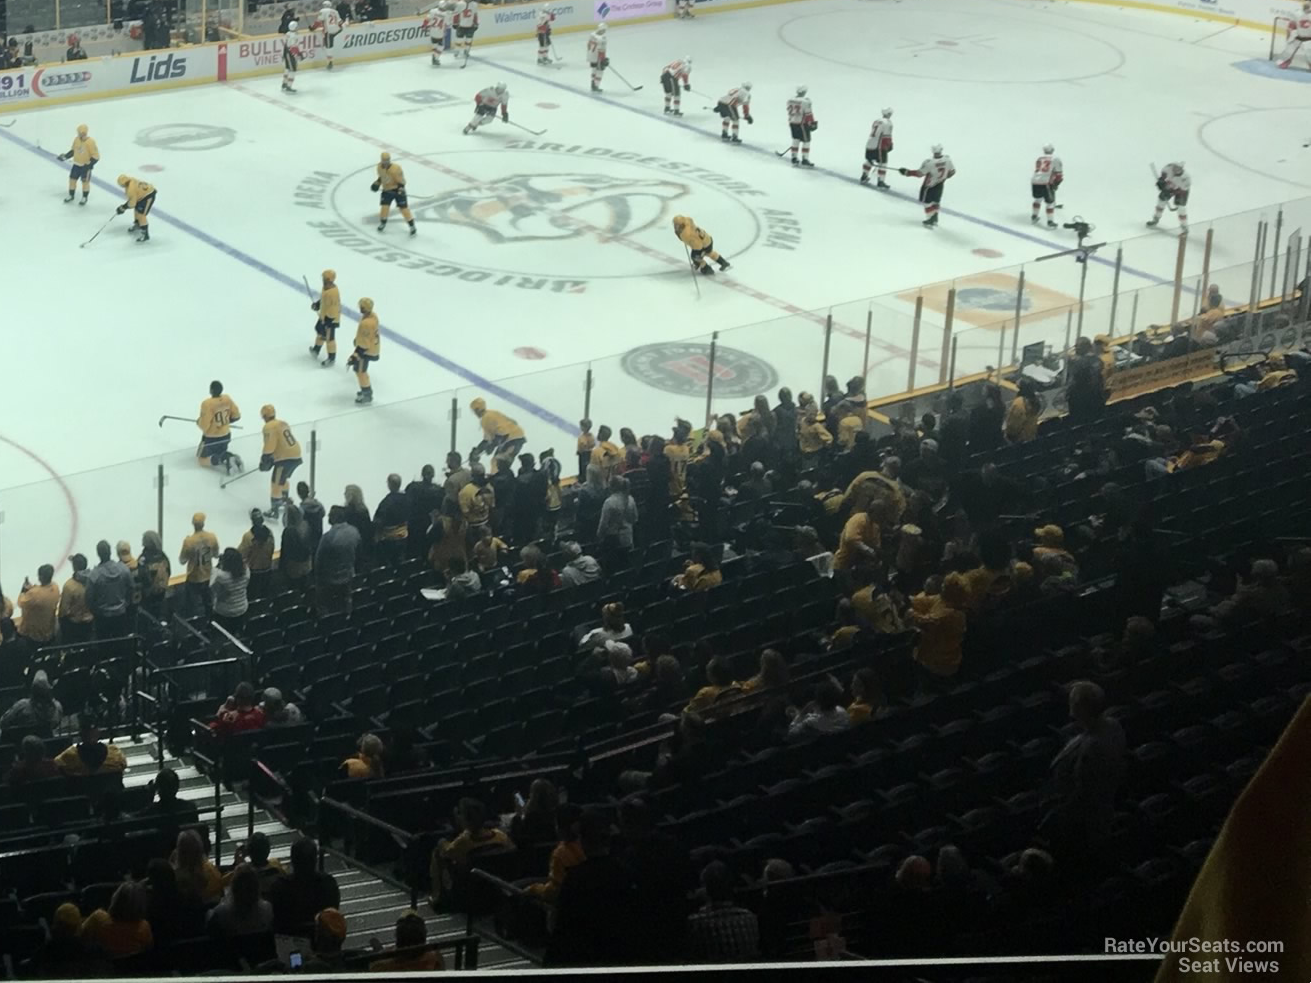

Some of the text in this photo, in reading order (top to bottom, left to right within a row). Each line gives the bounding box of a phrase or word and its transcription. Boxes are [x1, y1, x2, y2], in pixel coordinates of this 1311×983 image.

[494, 8, 536, 25] Walmart
[343, 26, 431, 49] BRIDGESTONE
[130, 53, 186, 83] Lids
[503, 138, 767, 197] BRIDGESTONE
[292, 169, 340, 210] ARENA
[306, 219, 589, 294] BRIDGESTONE
[283, 429, 296, 447] 8
